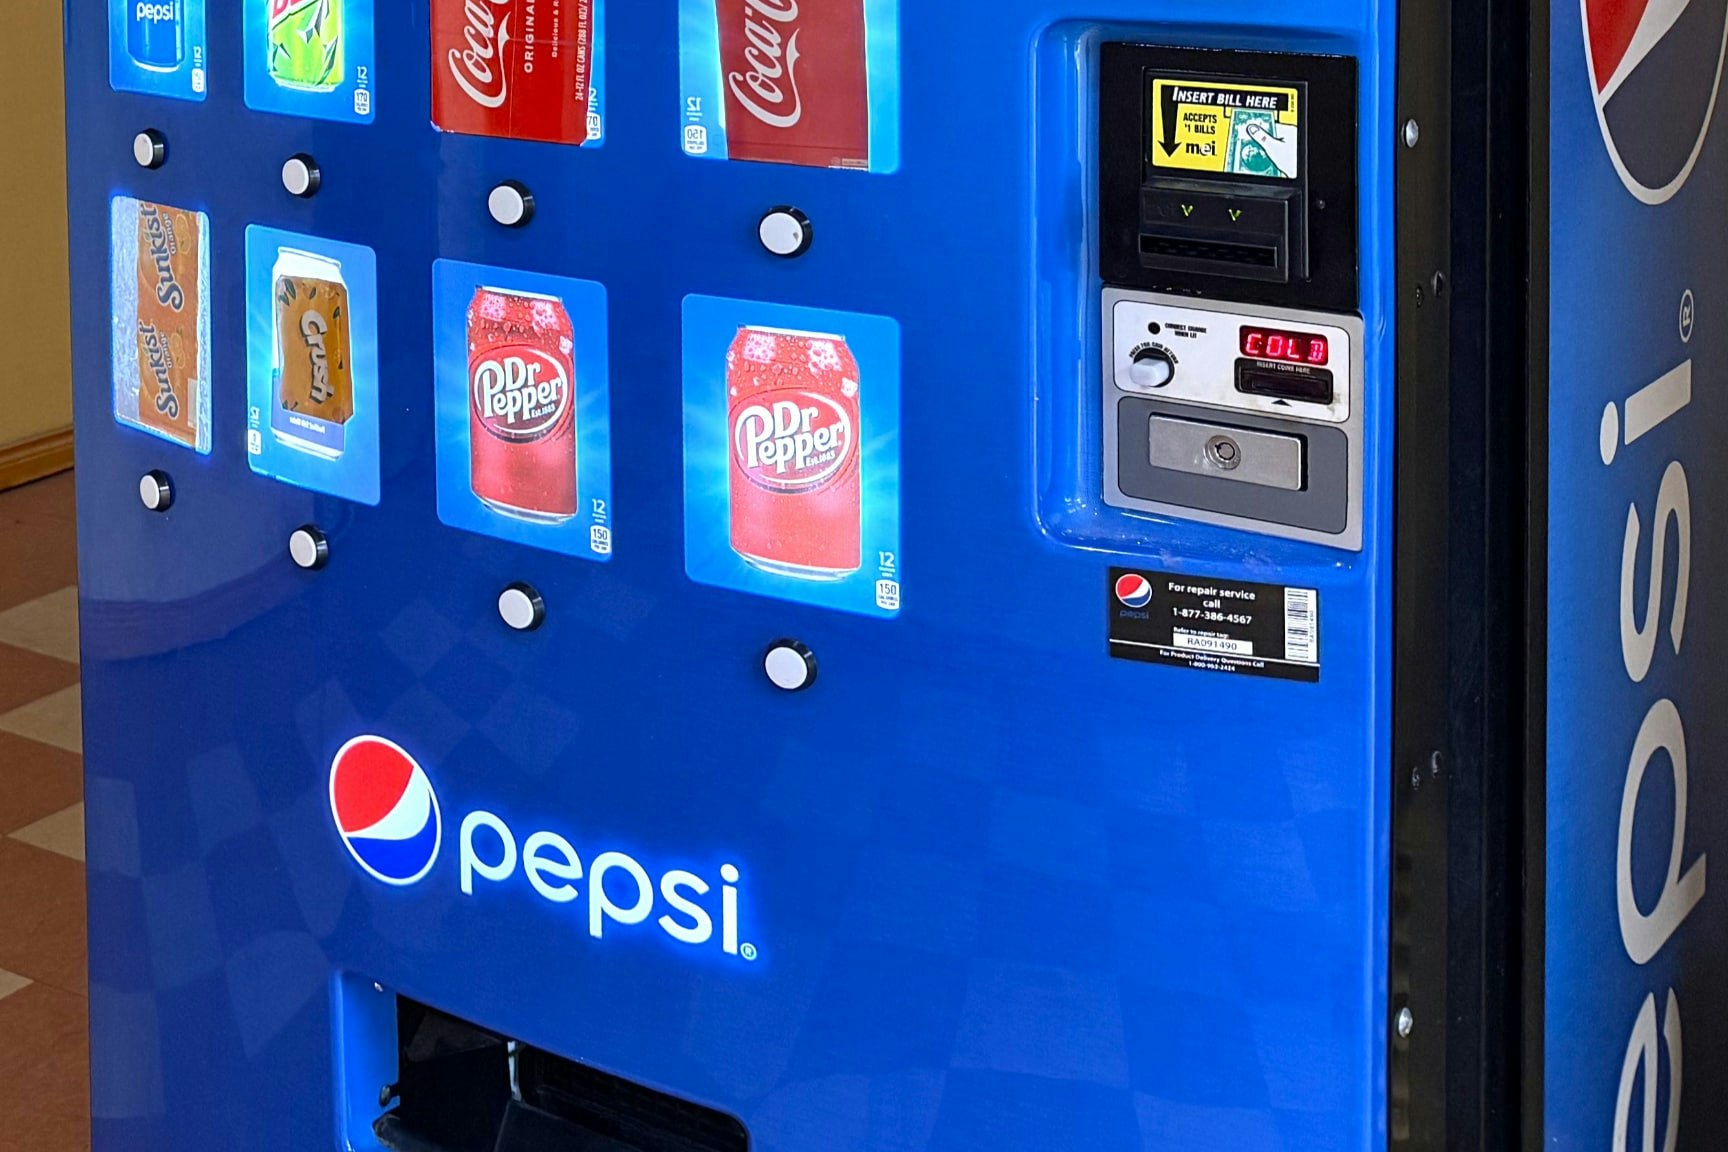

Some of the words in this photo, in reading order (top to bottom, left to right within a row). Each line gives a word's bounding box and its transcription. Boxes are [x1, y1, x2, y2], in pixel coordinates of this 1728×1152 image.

[136, 1, 174, 25] pepsi
[551, 14, 560, 58] Delicious
[357, 66, 368, 79] 12
[356, 92, 368, 102] 170
[1172, 86, 1215, 104] INSERT
[1216, 91, 1242, 106] BILL
[1245, 95, 1277, 108] HERE
[1183, 112, 1217, 124] ACCEPTS
[1194, 124, 1216, 135] BILLS
[1185, 140, 1216, 156] mei
[139, 200, 184, 312] Sunkist
[163, 212, 177, 256] orange
[1246, 333, 1325, 362] COLD
[299, 309, 335, 405] Crush
[138, 319, 179, 421] Sunkist
[503, 356, 541, 387] Dr
[482, 359, 563, 425] Pepper
[772, 400, 819, 440] Dr
[746, 404, 845, 474] Pepper
[591, 498, 606, 514] 12
[593, 528, 608, 540] 150
[879, 551, 894, 567] 12
[880, 583, 897, 595] 150
[1168, 582, 1185, 593] For
[1187, 585, 1217, 598] repair
[1219, 589, 1256, 600] service
[1203, 599, 1221, 609] call
[1119, 610, 1149, 620] pepsi
[1172, 607, 1252, 625] 1-877-386-4567
[1198, 630, 1215, 638] repair
[1187, 637, 1237, 650] RA091490
[1170, 650, 1194, 659] Product
[1195, 653, 1220, 663] Delivery
[1221, 657, 1251, 666] Questions
[460, 810, 740, 956] pepsi
